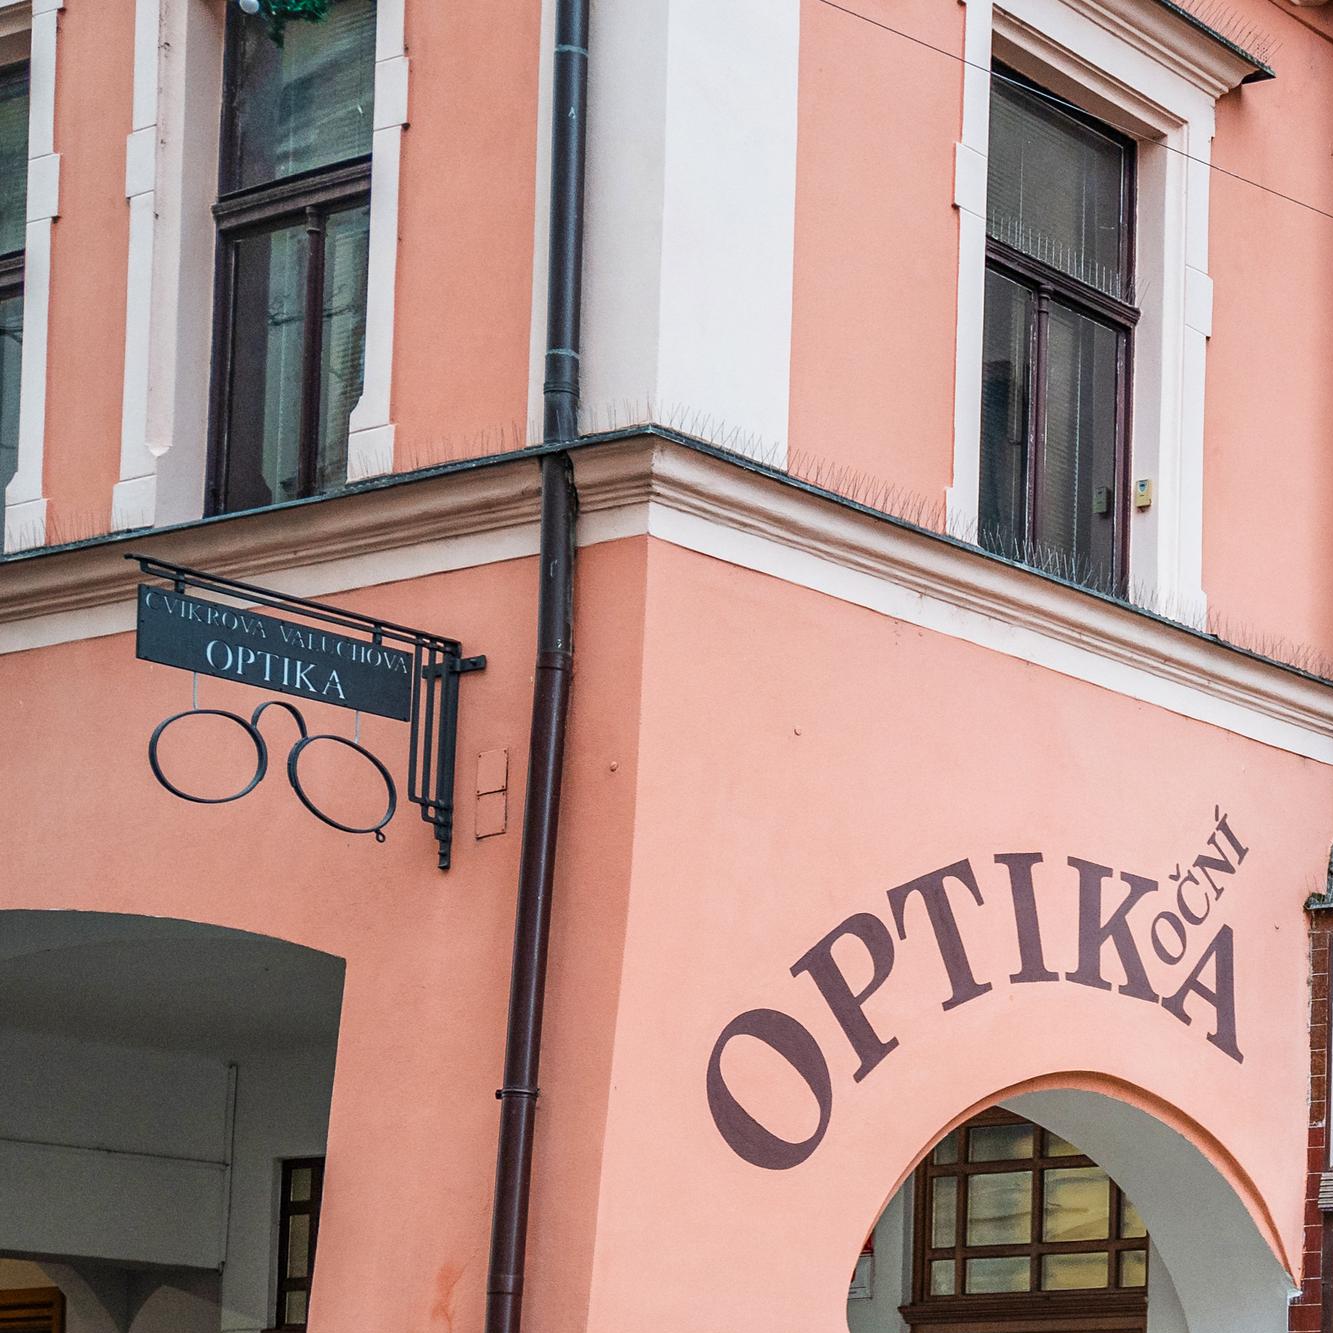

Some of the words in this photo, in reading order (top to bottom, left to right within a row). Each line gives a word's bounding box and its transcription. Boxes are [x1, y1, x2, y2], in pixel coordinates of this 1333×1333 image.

[206, 640, 345, 699] OPTIKA
[1150, 804, 1249, 966] OČNÍ
[706, 851, 1244, 1170] OPTIKA
